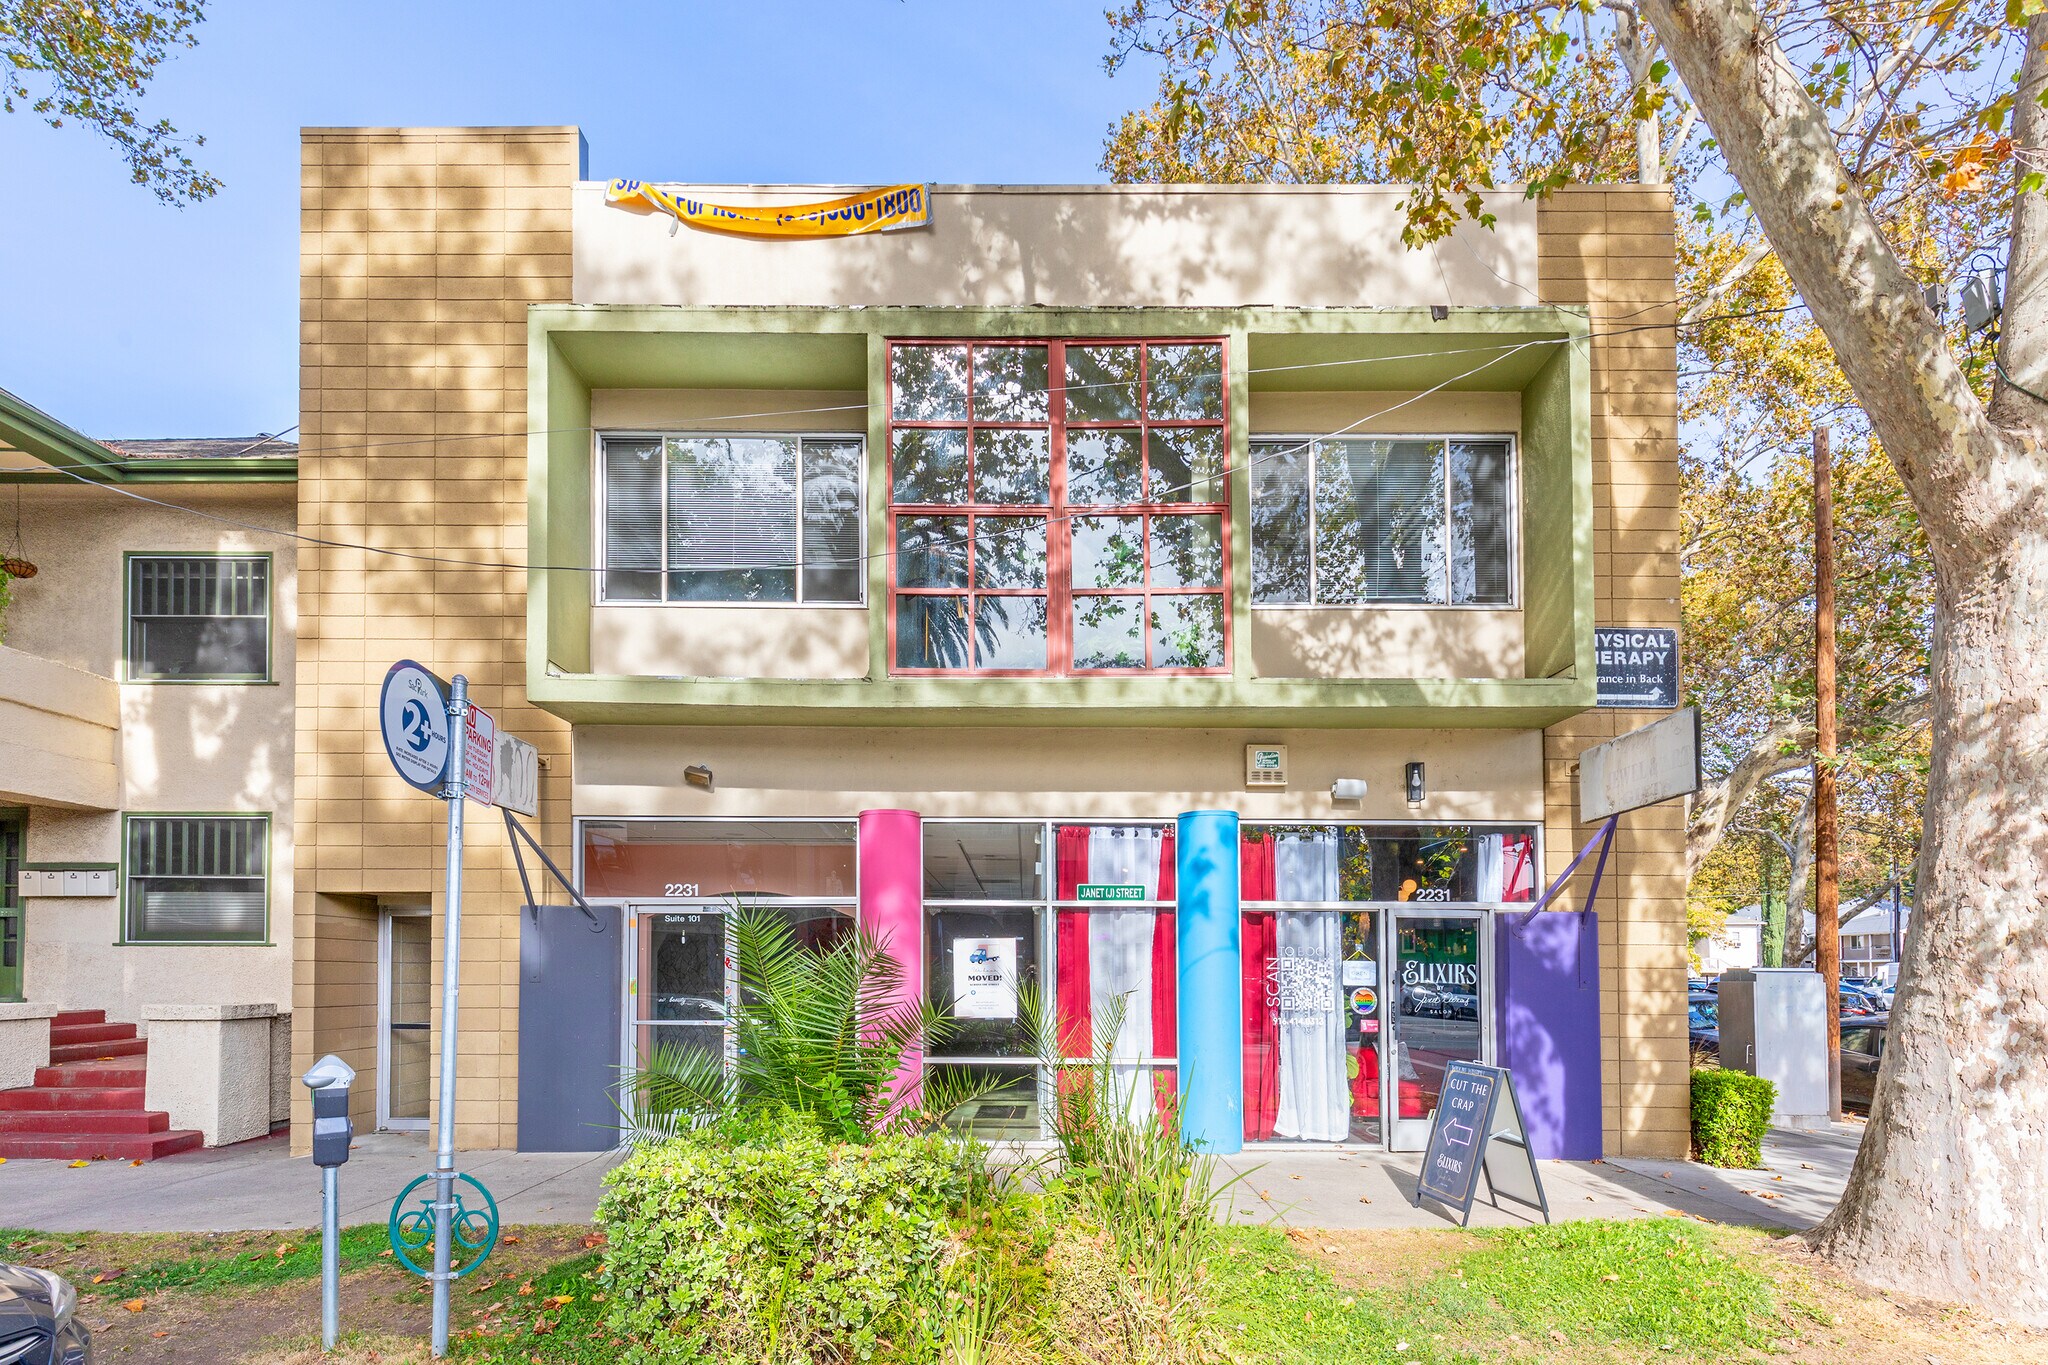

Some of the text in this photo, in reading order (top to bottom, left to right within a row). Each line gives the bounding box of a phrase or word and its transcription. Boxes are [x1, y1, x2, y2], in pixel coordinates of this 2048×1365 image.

[1626, 674, 1635, 684] in
[1640, 674, 1663, 684] Back
[431, 730, 446, 743] HOURS
[665, 884, 699, 896] 2231
[1081, 888, 1142, 898] JANET (J) STREET
[1416, 889, 1450, 901] 2231
[665, 914, 700, 922] Suite 101
[1278, 946, 1295, 956] TO
[1266, 957, 1280, 1007] SCAN
[1450, 1078, 1488, 1096] CUT THE
[1451, 1097, 1474, 1111] CRAP
